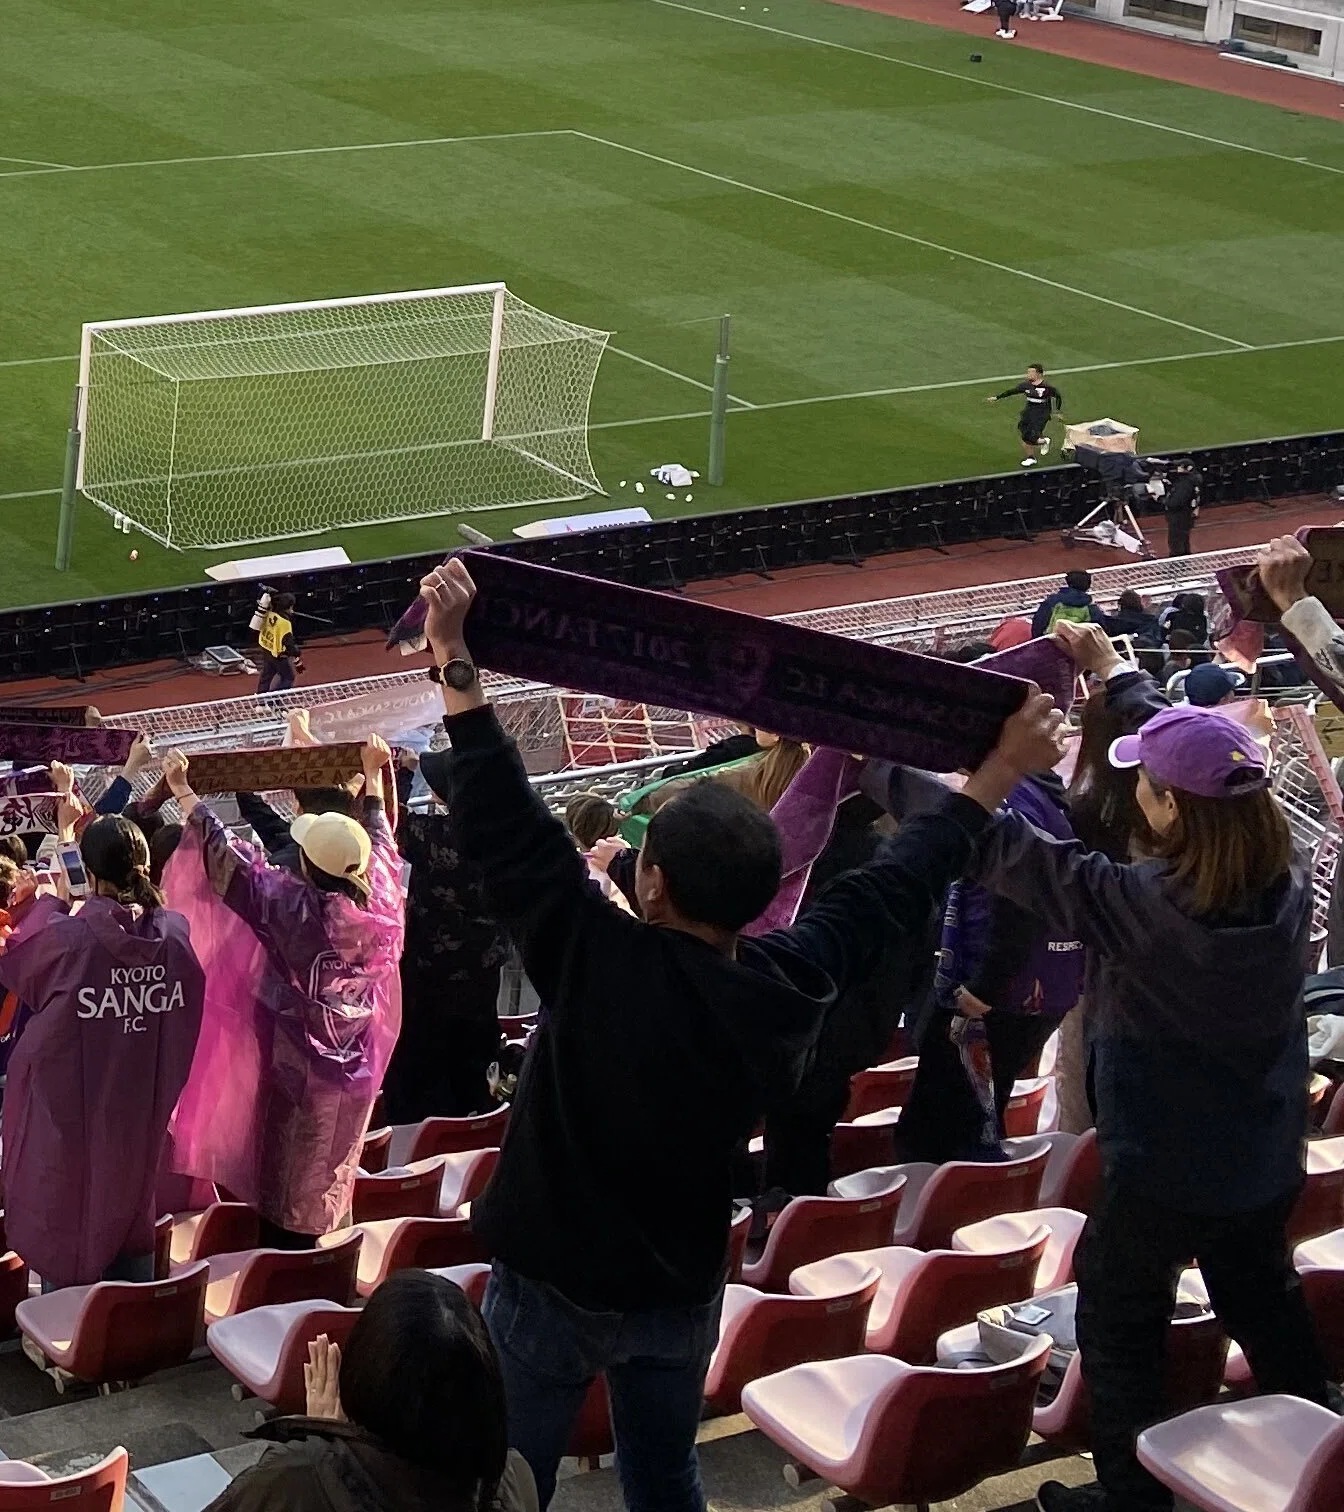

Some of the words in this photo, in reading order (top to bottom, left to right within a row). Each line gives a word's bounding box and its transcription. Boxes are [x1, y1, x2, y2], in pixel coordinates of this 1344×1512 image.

[110, 965, 166, 985] KYOTO
[77, 981, 185, 1019] SANGA
[123, 1016, 147, 1034] F.C.
